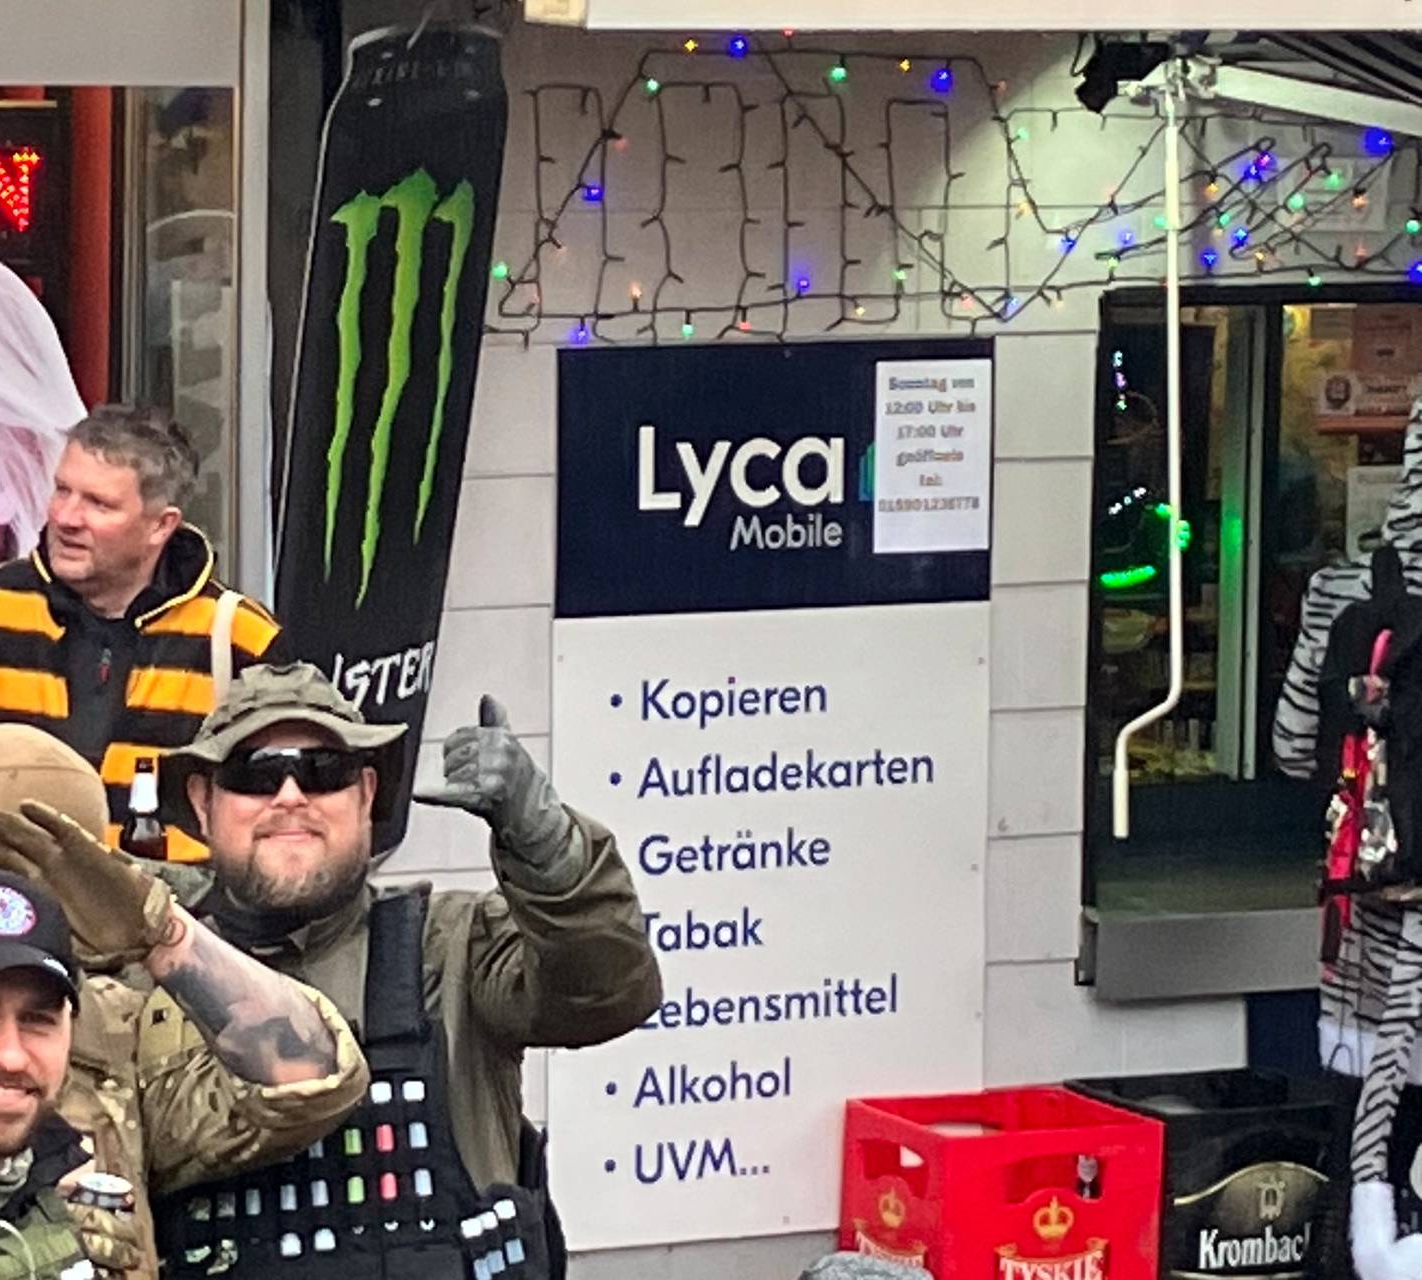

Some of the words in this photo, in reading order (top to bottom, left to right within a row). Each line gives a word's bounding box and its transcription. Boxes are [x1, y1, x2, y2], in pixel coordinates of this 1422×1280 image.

[638, 425, 845, 527] Lyca
[730, 512, 843, 551] Mobile
[332, 641, 435, 713] STER
[641, 675, 827, 730] Kopieren
[637, 748, 934, 799] Aufladekarten
[639, 826, 831, 877] Getränke
[633, 1056, 791, 1108] Alkohol
[635, 1136, 770, 1184] UVM...
